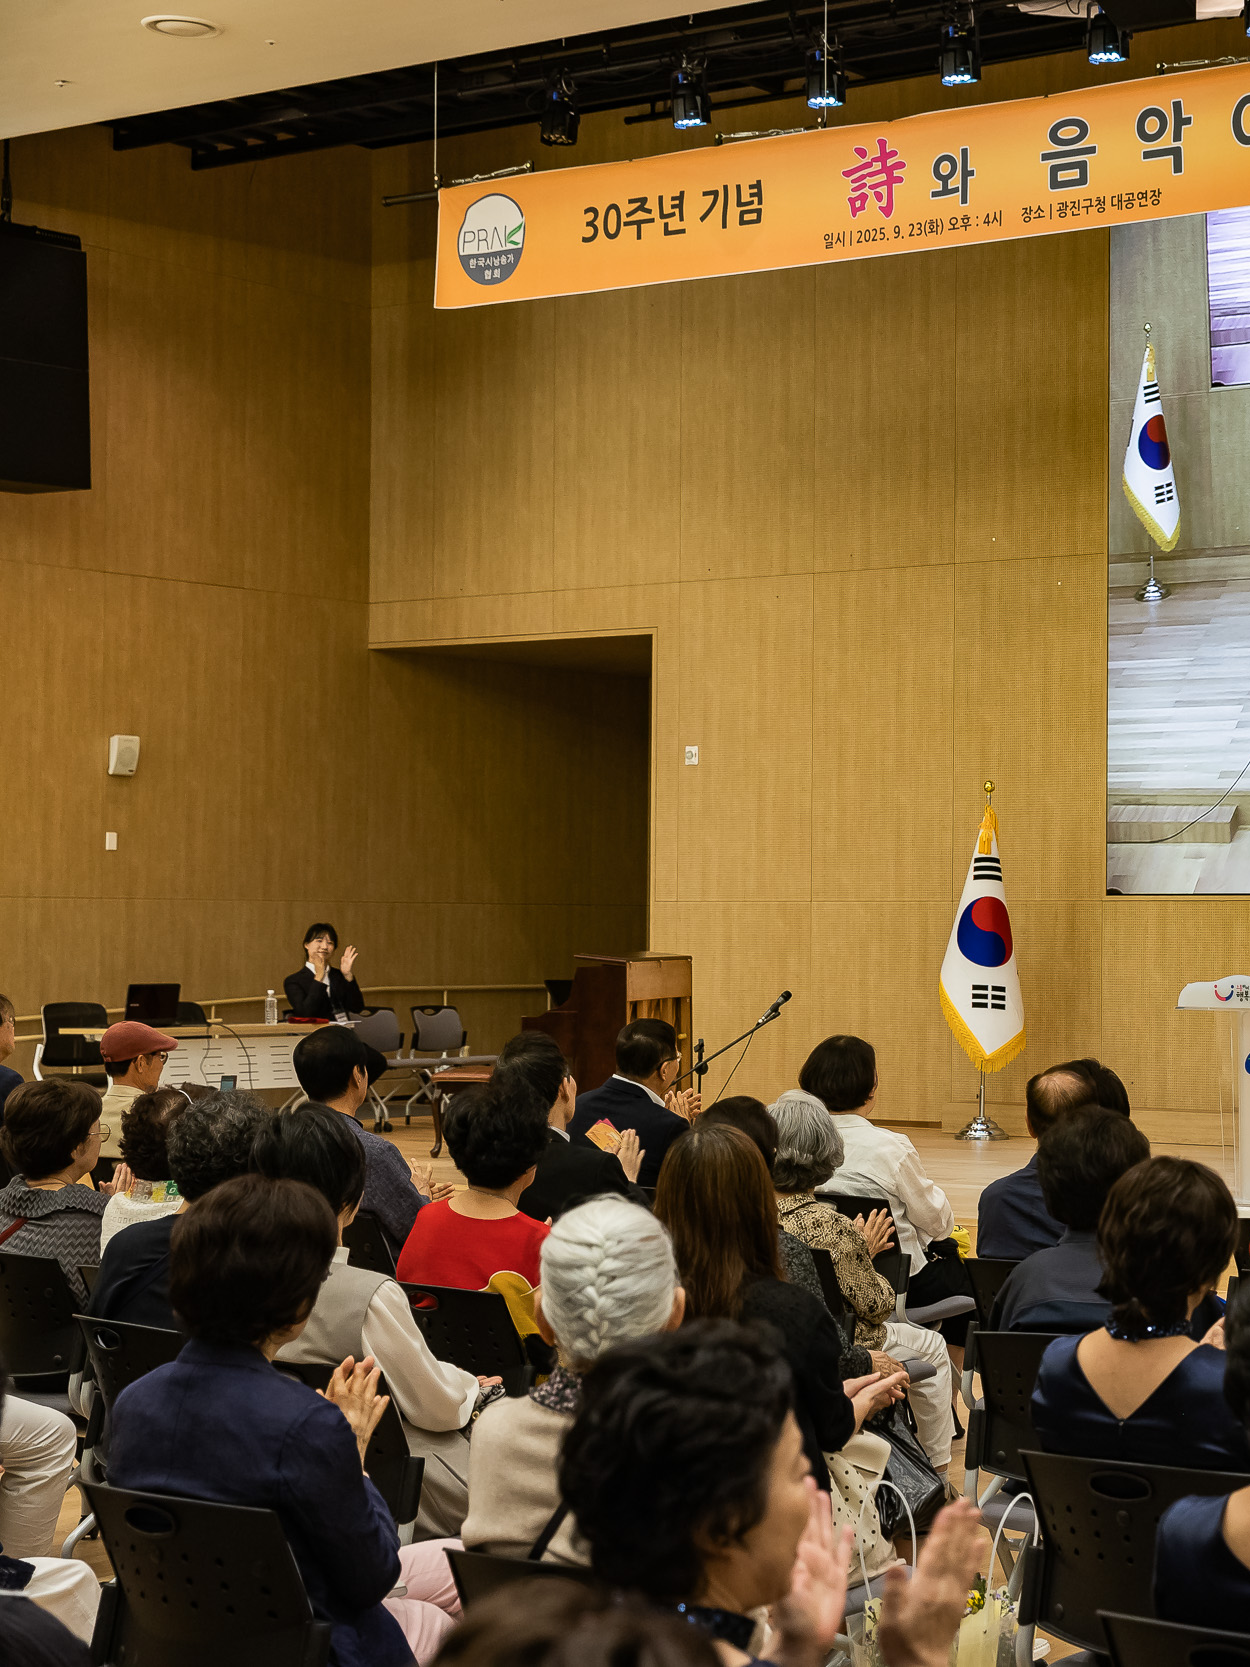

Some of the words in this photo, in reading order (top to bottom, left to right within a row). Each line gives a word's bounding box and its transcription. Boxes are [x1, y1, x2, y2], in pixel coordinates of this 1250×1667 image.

[581, 190, 686, 243] 30주년
[699, 179, 763, 229] 기념
[1021, 205, 1045, 223] 장소
[1056, 196, 1106, 218] 광진구청
[1111, 188, 1162, 211] 대공연장
[823, 231, 845, 249] 일시
[857, 227, 890, 244] 2025.
[908, 218, 944, 237] 23(화)
[948, 214, 972, 231] 오후
[983, 210, 1002, 227] 4시
